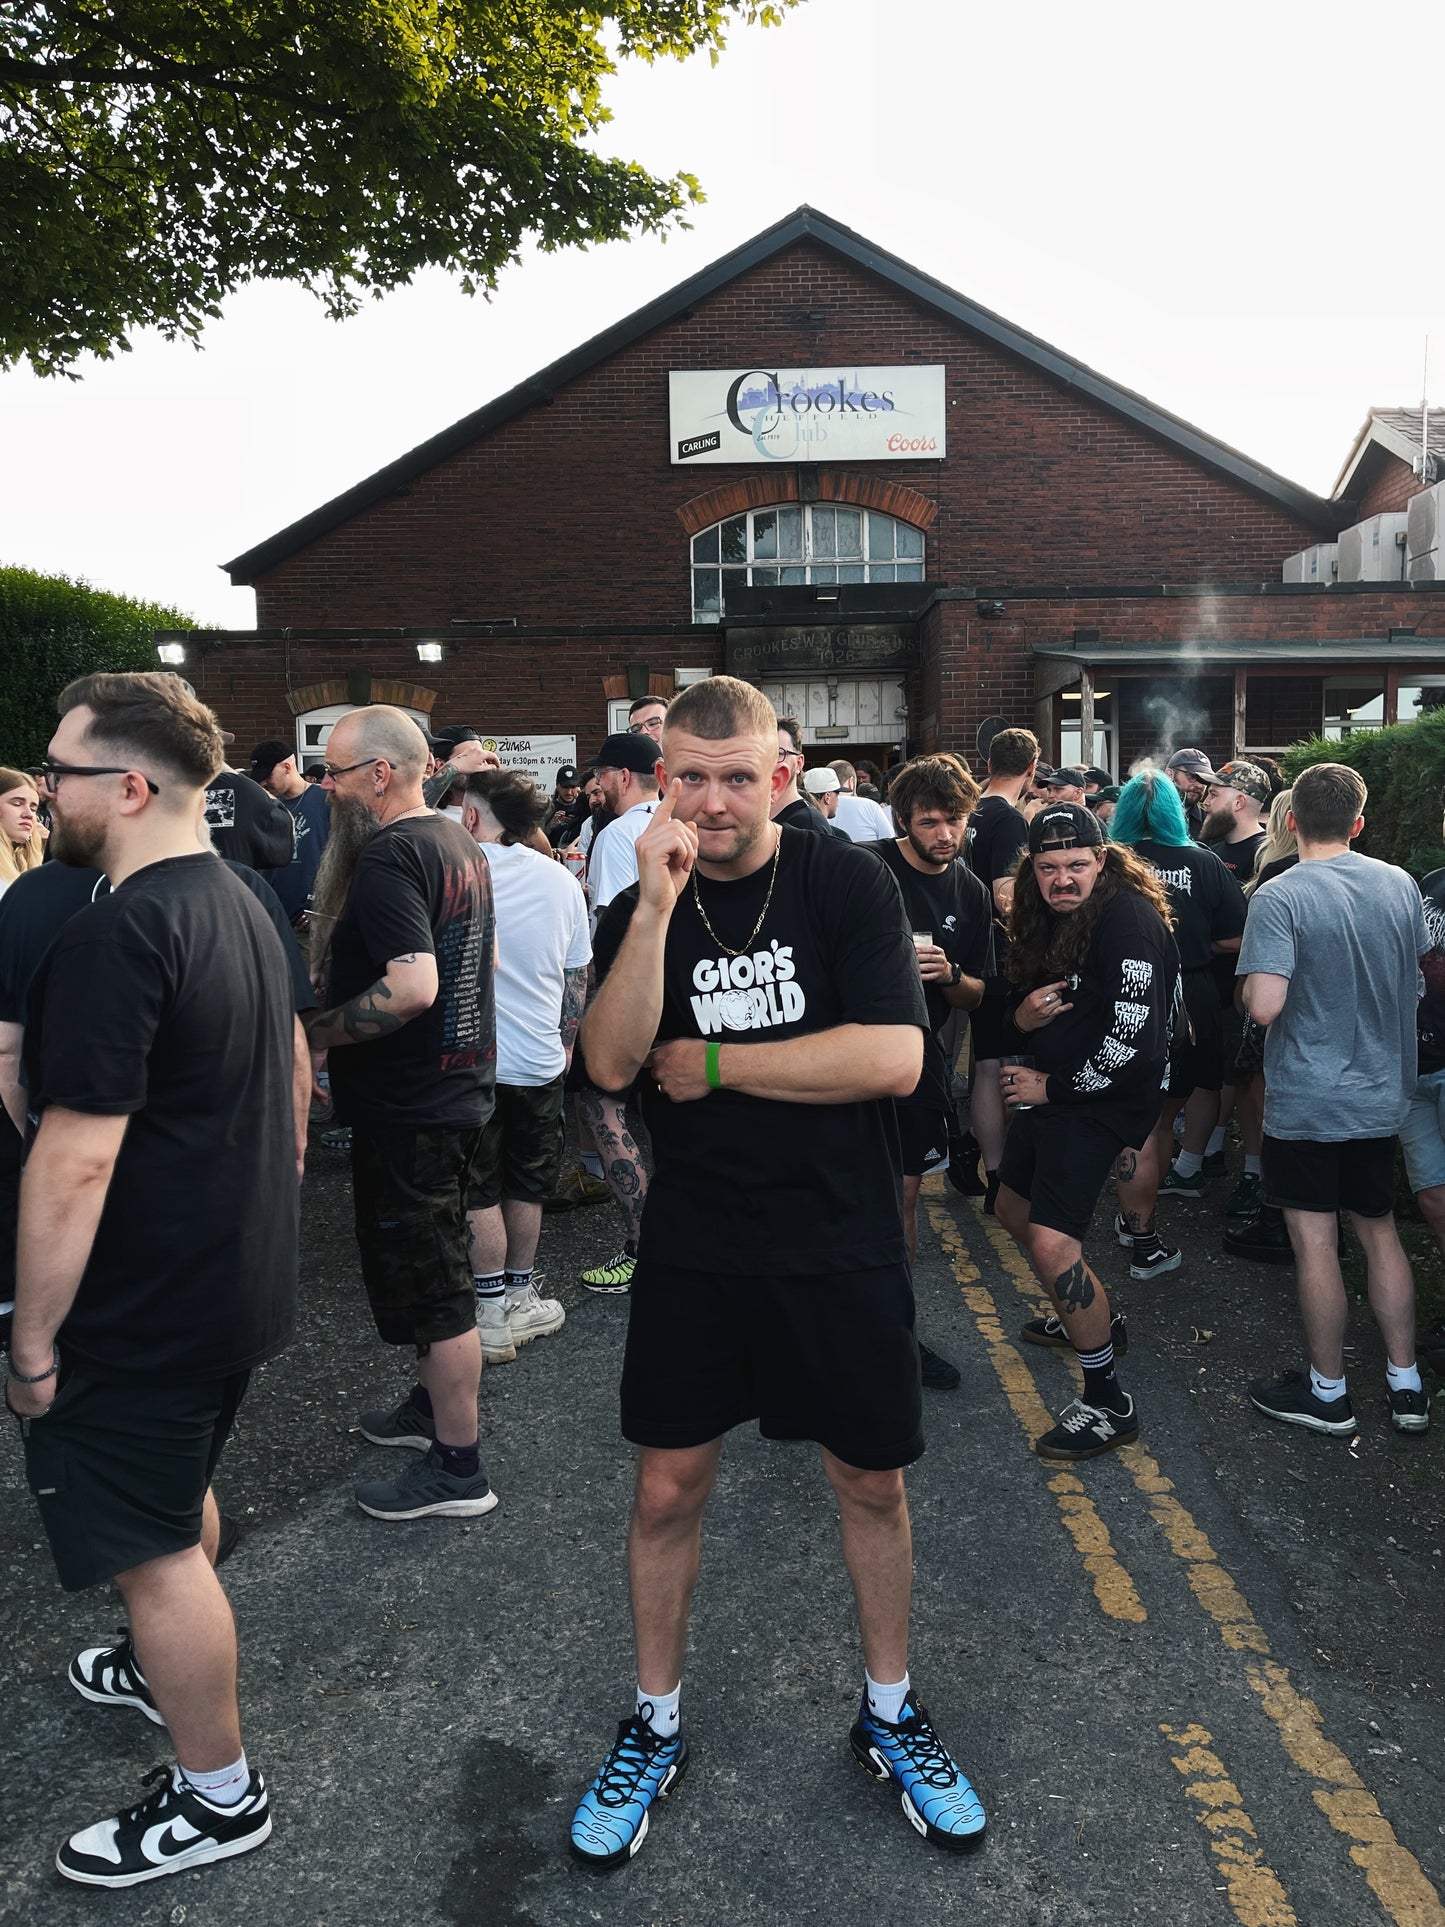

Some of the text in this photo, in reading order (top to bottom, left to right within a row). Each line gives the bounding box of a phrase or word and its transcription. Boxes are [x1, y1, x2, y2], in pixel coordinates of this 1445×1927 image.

[726, 371, 895, 435] Crookes
[750, 413, 878, 422] SHEFFIELD
[752, 405, 828, 460] Club
[682, 436, 717, 454] CARLING
[886, 433, 938, 452] Coors
[734, 638, 798, 661] CROOKES
[817, 648, 855, 665] 1926
[498, 738, 532, 752] ZUMBA
[512, 757, 538, 766] 6:30pm
[548, 757, 573, 766] 7:45pm
[1121, 958, 1153, 977] POWER
[1125, 968, 1151, 983] TRIP
[689, 980, 806, 1035] WORLD
[1114, 1001, 1150, 1020] POWER
[1118, 1011, 1147, 1026] TRIP
[1103, 1035, 1139, 1058] POWER
[1104, 1044, 1135, 1063] TRIP
